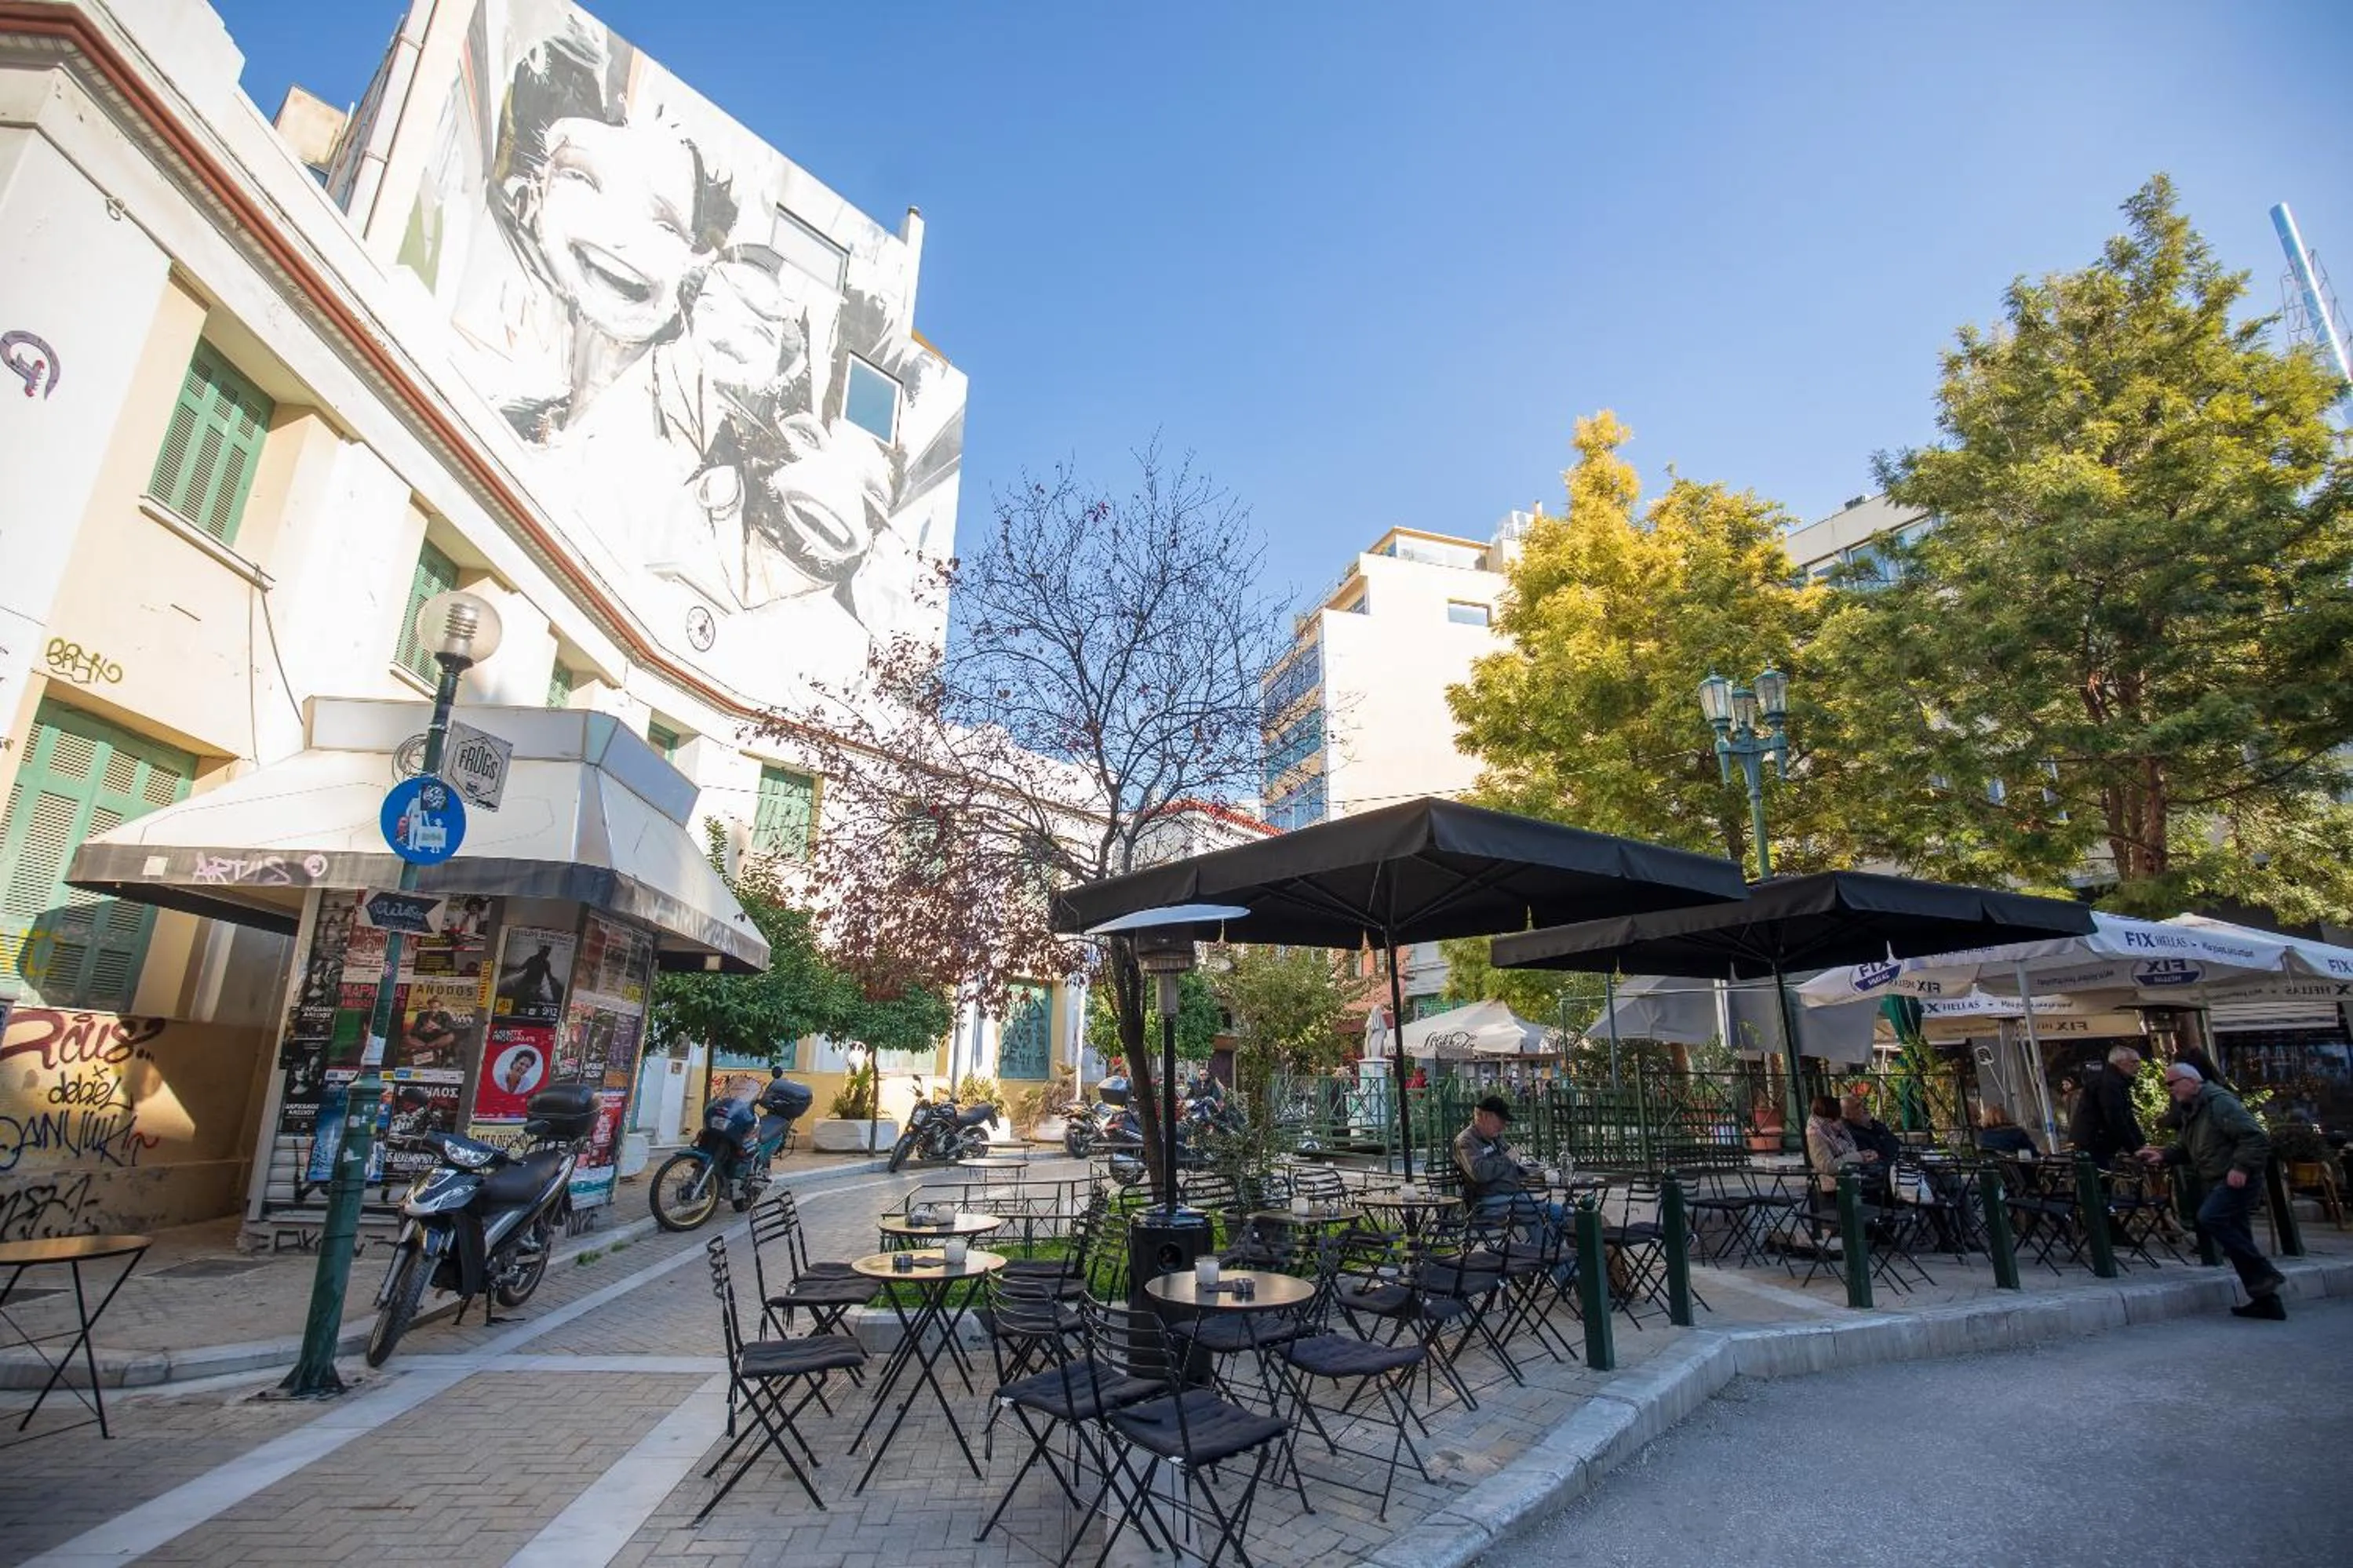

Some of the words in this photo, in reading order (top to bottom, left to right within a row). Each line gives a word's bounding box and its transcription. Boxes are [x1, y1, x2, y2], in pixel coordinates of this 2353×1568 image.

[458, 746, 497, 780] FROGS
[2124, 930, 2155, 948] FIX
[2155, 935, 2187, 948] HELLAS
[2327, 959, 2352, 973] FIX
[1943, 1000, 1981, 1010] HELLAS
